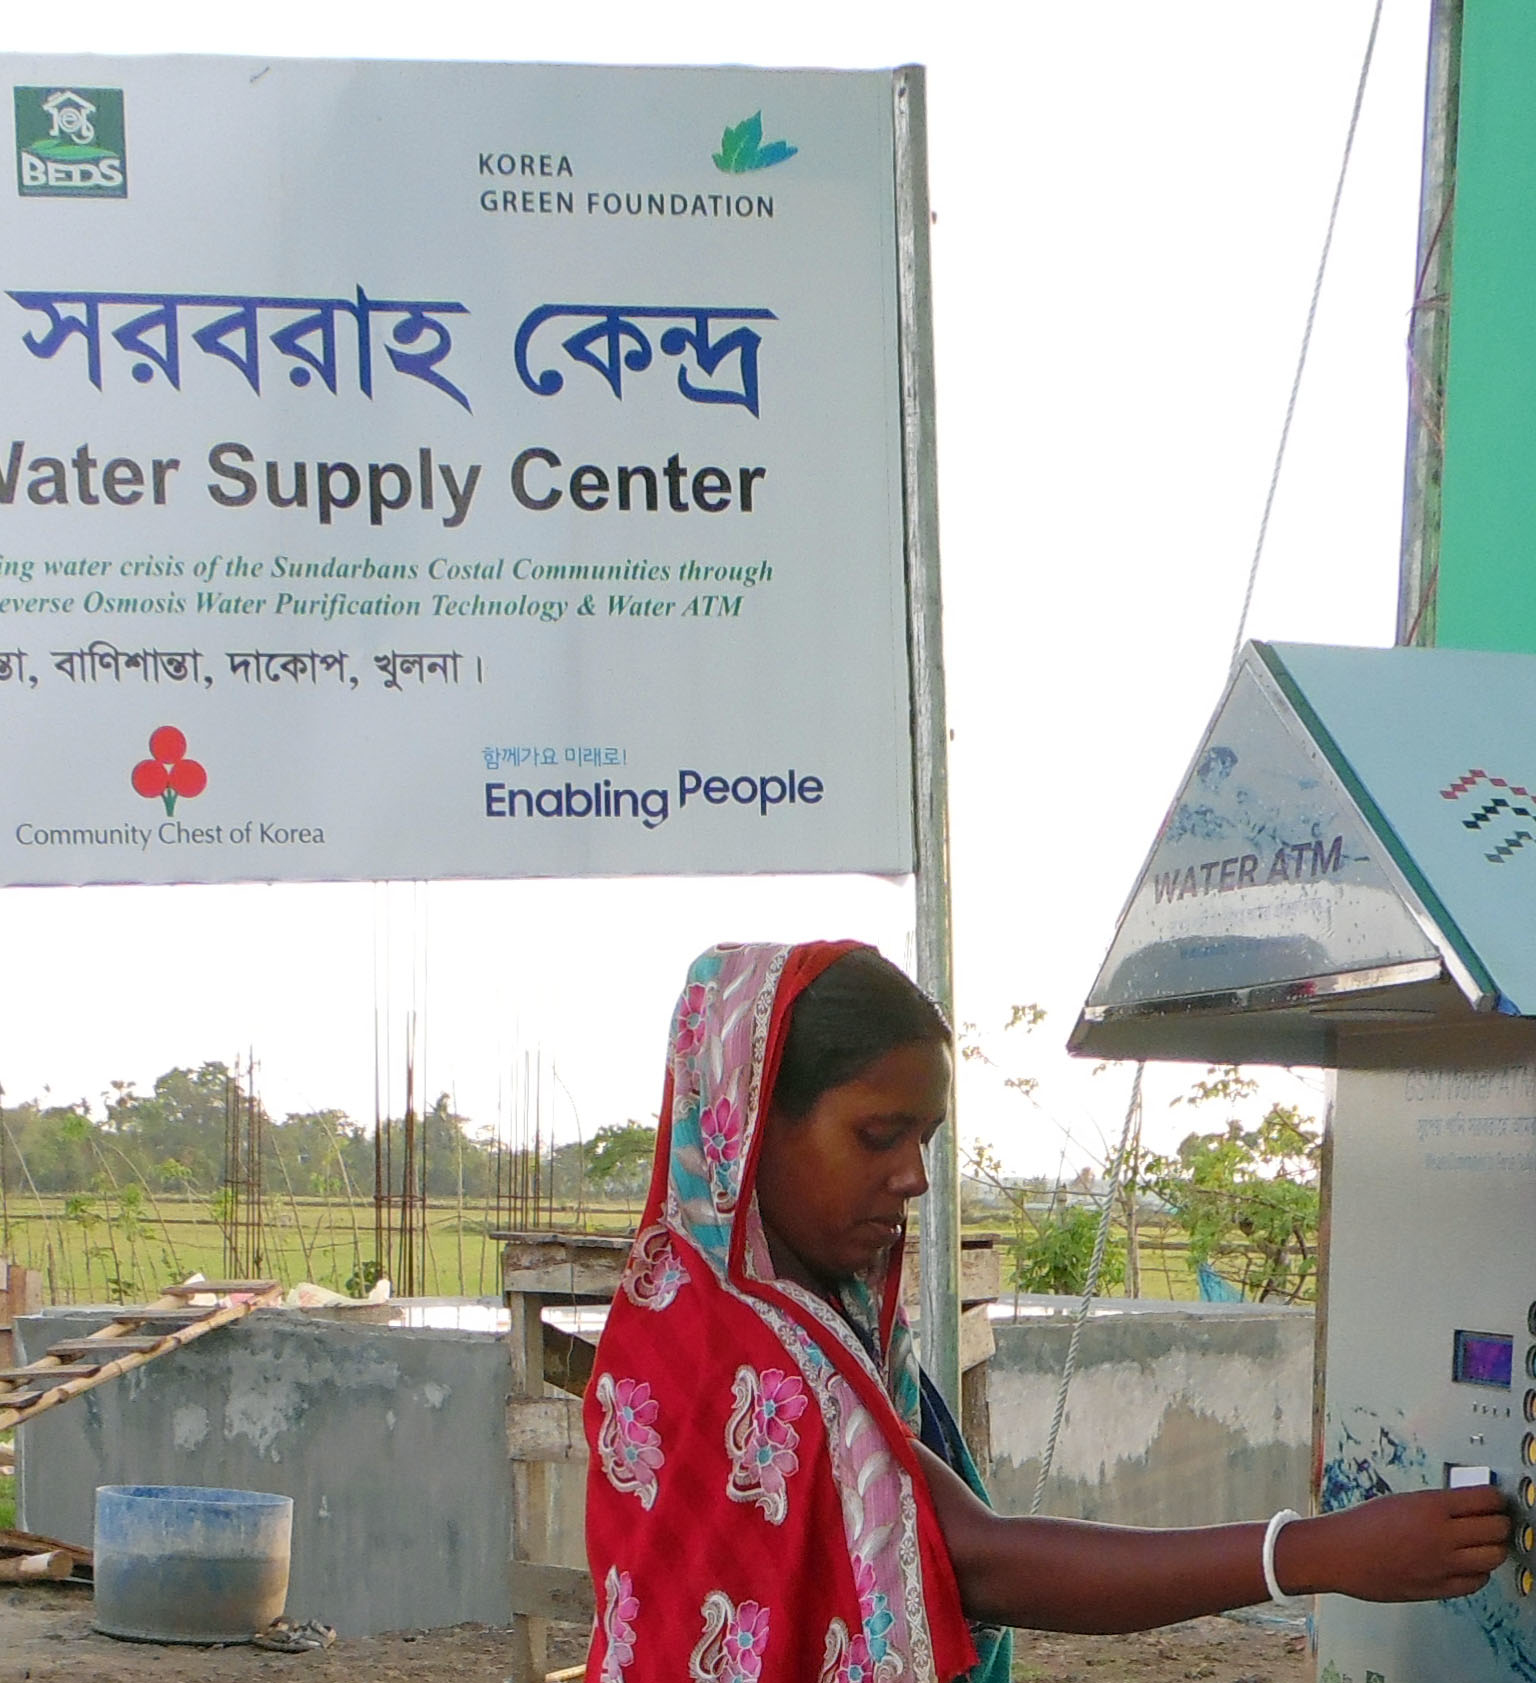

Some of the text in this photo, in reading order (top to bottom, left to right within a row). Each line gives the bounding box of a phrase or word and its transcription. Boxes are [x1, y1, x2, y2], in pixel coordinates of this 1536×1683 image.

[21, 150, 124, 187] BEDS
[479, 152, 573, 178] KOREA
[480, 190, 774, 218] GREEN FOUNDATION
[4, 282, 473, 415] সরবরাহ
[513, 303, 779, 420] কেন্দ্র
[207, 442, 482, 528] Supply
[510, 447, 767, 513] Center
[44, 558, 113, 577] water
[119, 554, 185, 577] crisis
[192, 554, 223, 584] of
[225, 555, 264, 578] the
[270, 556, 418, 580] Sundarbans
[428, 558, 505, 580] Costal
[512, 558, 671, 581] Communities
[679, 559, 773, 588] through
[83, 590, 187, 614] Osmosis
[197, 591, 267, 615] Water
[274, 592, 421, 622] Purification
[432, 594, 569, 623] Technology
[576, 594, 596, 616] &
[608, 594, 676, 617] Water
[681, 595, 743, 617] ATM
[49, 640, 214, 690] বাণিশান্তা,
[224, 648, 359, 690] দাকোপ,
[373, 649, 464, 692] খুলনা
[481, 746, 627, 771] 함께가요 미래로!
[485, 769, 824, 830] Enabling People
[15, 820, 325, 852] Community Chest of Korea
[1154, 835, 1344, 905] WATER ATM
